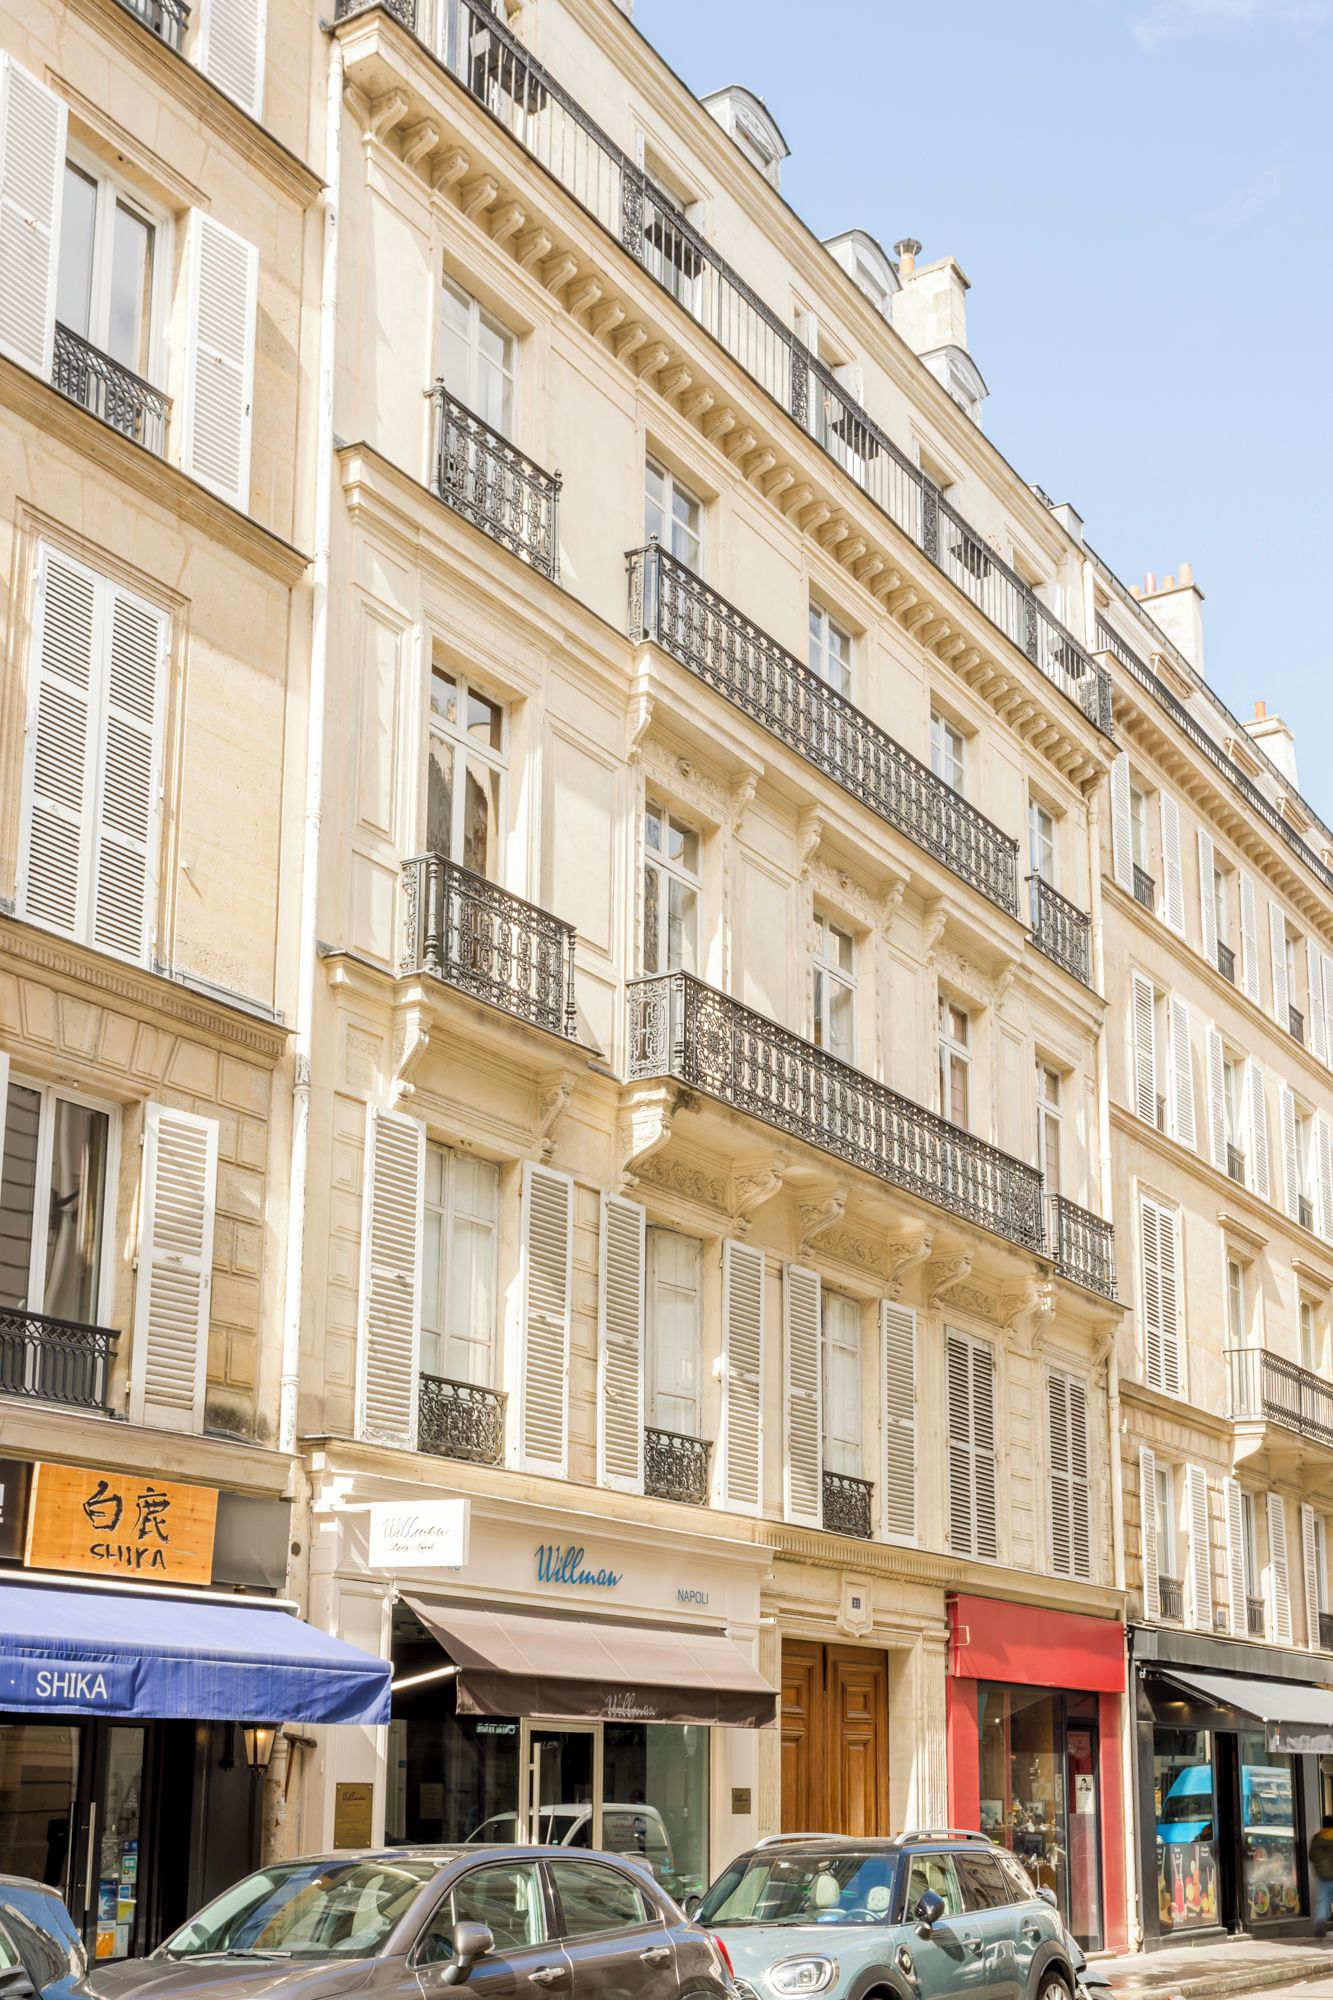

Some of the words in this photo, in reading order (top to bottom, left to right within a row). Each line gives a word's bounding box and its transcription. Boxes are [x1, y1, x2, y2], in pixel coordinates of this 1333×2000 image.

[83, 1480, 170, 1543] 白鹿
[90, 1543, 166, 1569] SHIKA
[534, 1544, 623, 1587] Willman
[677, 1588, 709, 1605] NAPOLI
[36, 1670, 107, 1699] SHIKA
